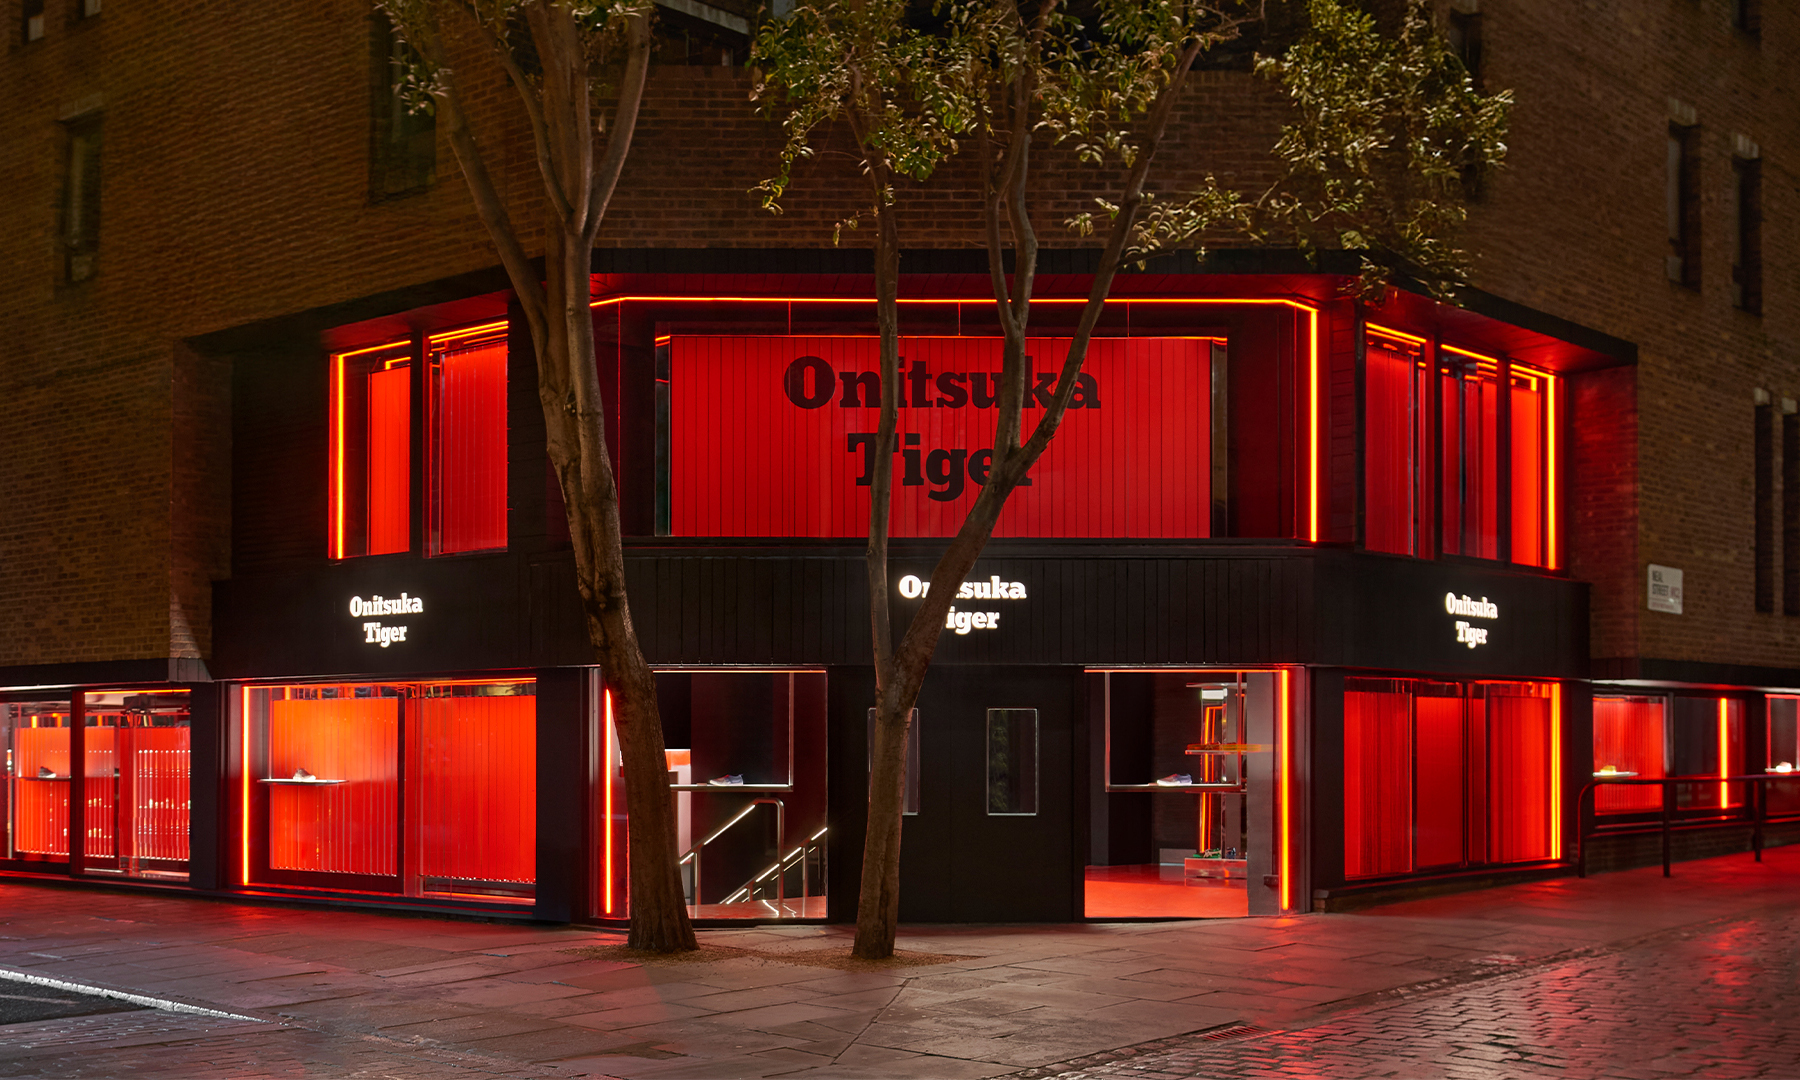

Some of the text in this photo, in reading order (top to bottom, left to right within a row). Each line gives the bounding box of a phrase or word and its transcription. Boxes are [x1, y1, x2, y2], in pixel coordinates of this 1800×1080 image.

[847, 432, 1033, 502] Tige
[898, 574, 1027, 599] Osuka
[349, 592, 424, 617] Onitsuka
[1445, 592, 1498, 619] Onitsuka
[945, 605, 1000, 635] iger
[363, 622, 408, 648] Tiger
[1455, 620, 1488, 649] Tiger
